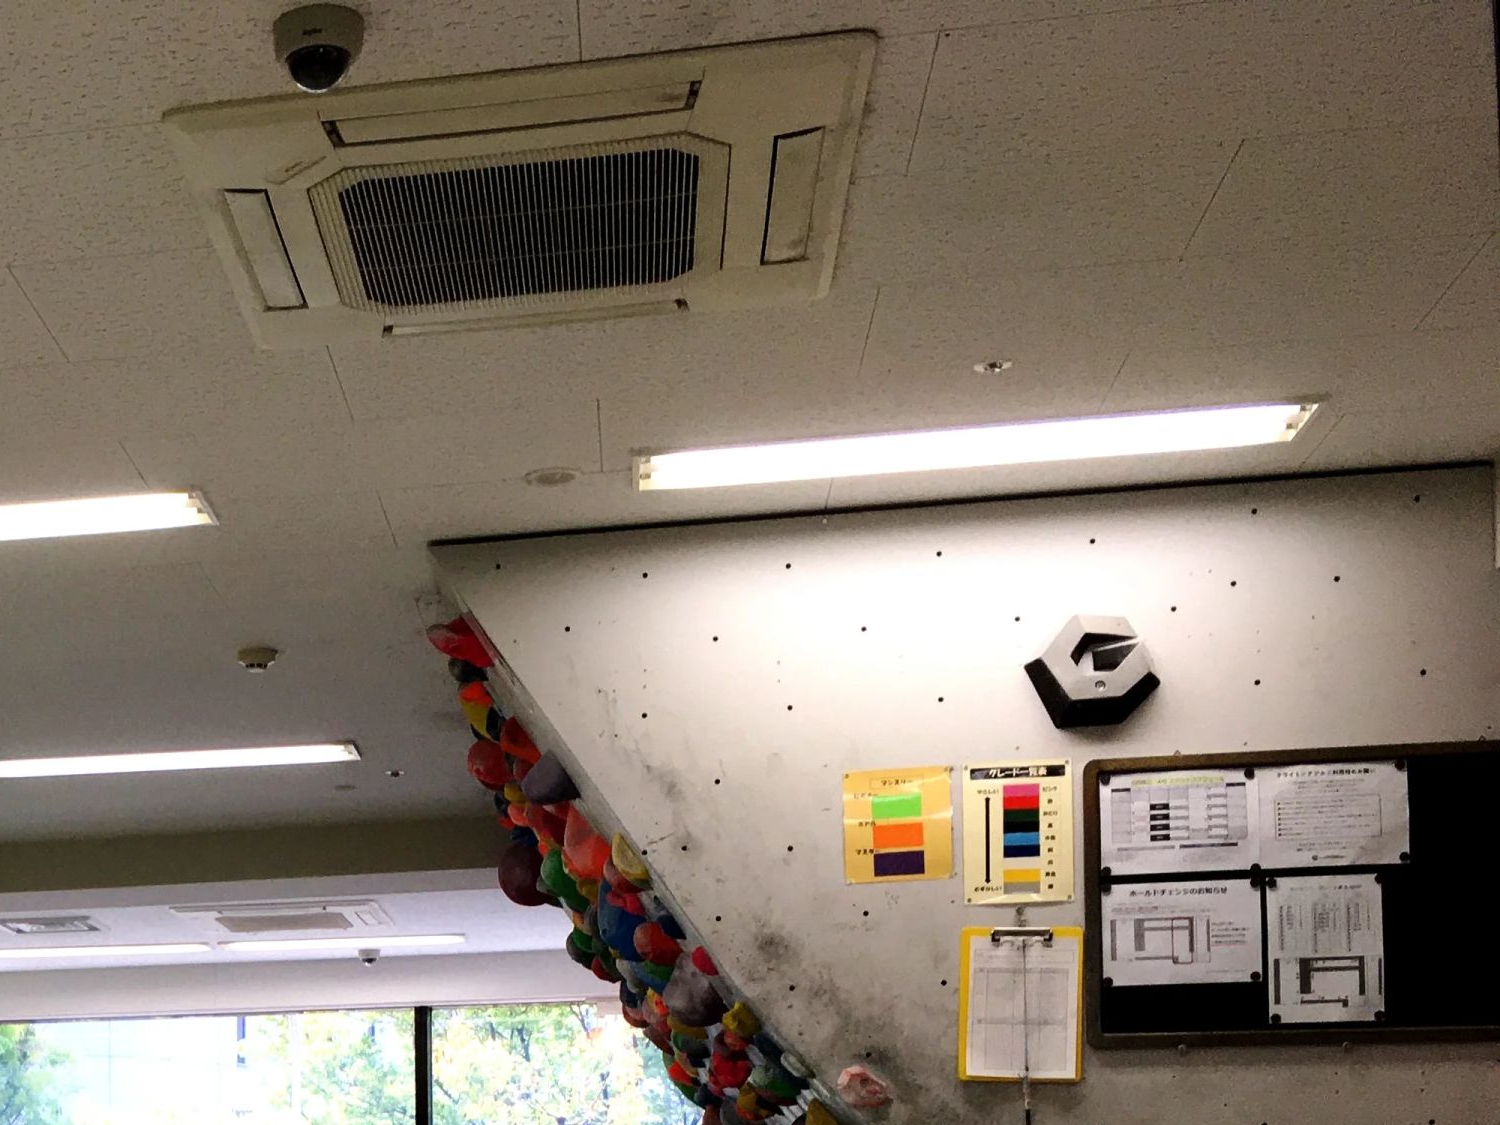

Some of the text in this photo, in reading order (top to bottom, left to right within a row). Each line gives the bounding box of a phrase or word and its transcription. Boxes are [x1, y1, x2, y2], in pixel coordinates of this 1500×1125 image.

[1129, 886, 1228, 897] ホールドチェンジのお知らせ
